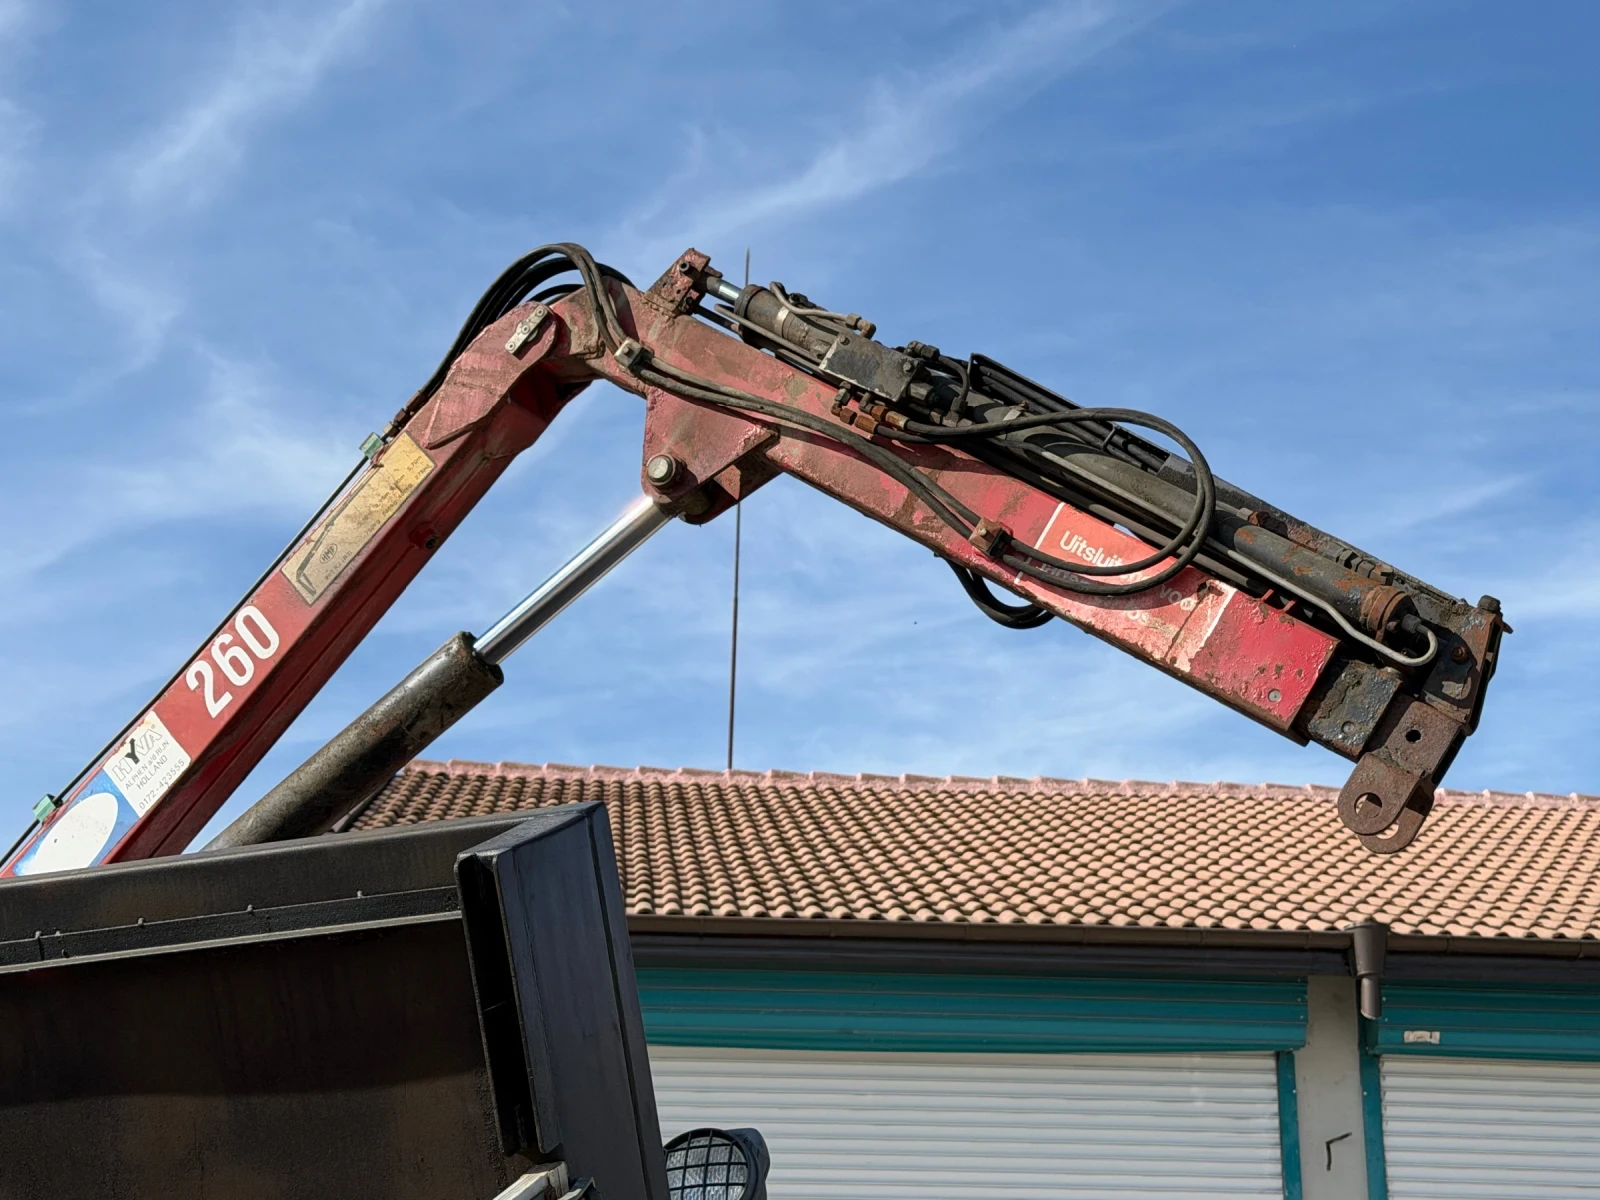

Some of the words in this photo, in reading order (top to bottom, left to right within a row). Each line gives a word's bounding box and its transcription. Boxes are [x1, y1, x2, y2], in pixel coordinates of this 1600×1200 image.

[321, 545, 336, 563] HMF
[186, 605, 280, 719] 260
[112, 728, 163, 782] HYVA
[125, 763, 148, 790] ALPHEN
[156, 740, 170, 756] RIJN
[137, 754, 168, 790] HOLLAND
